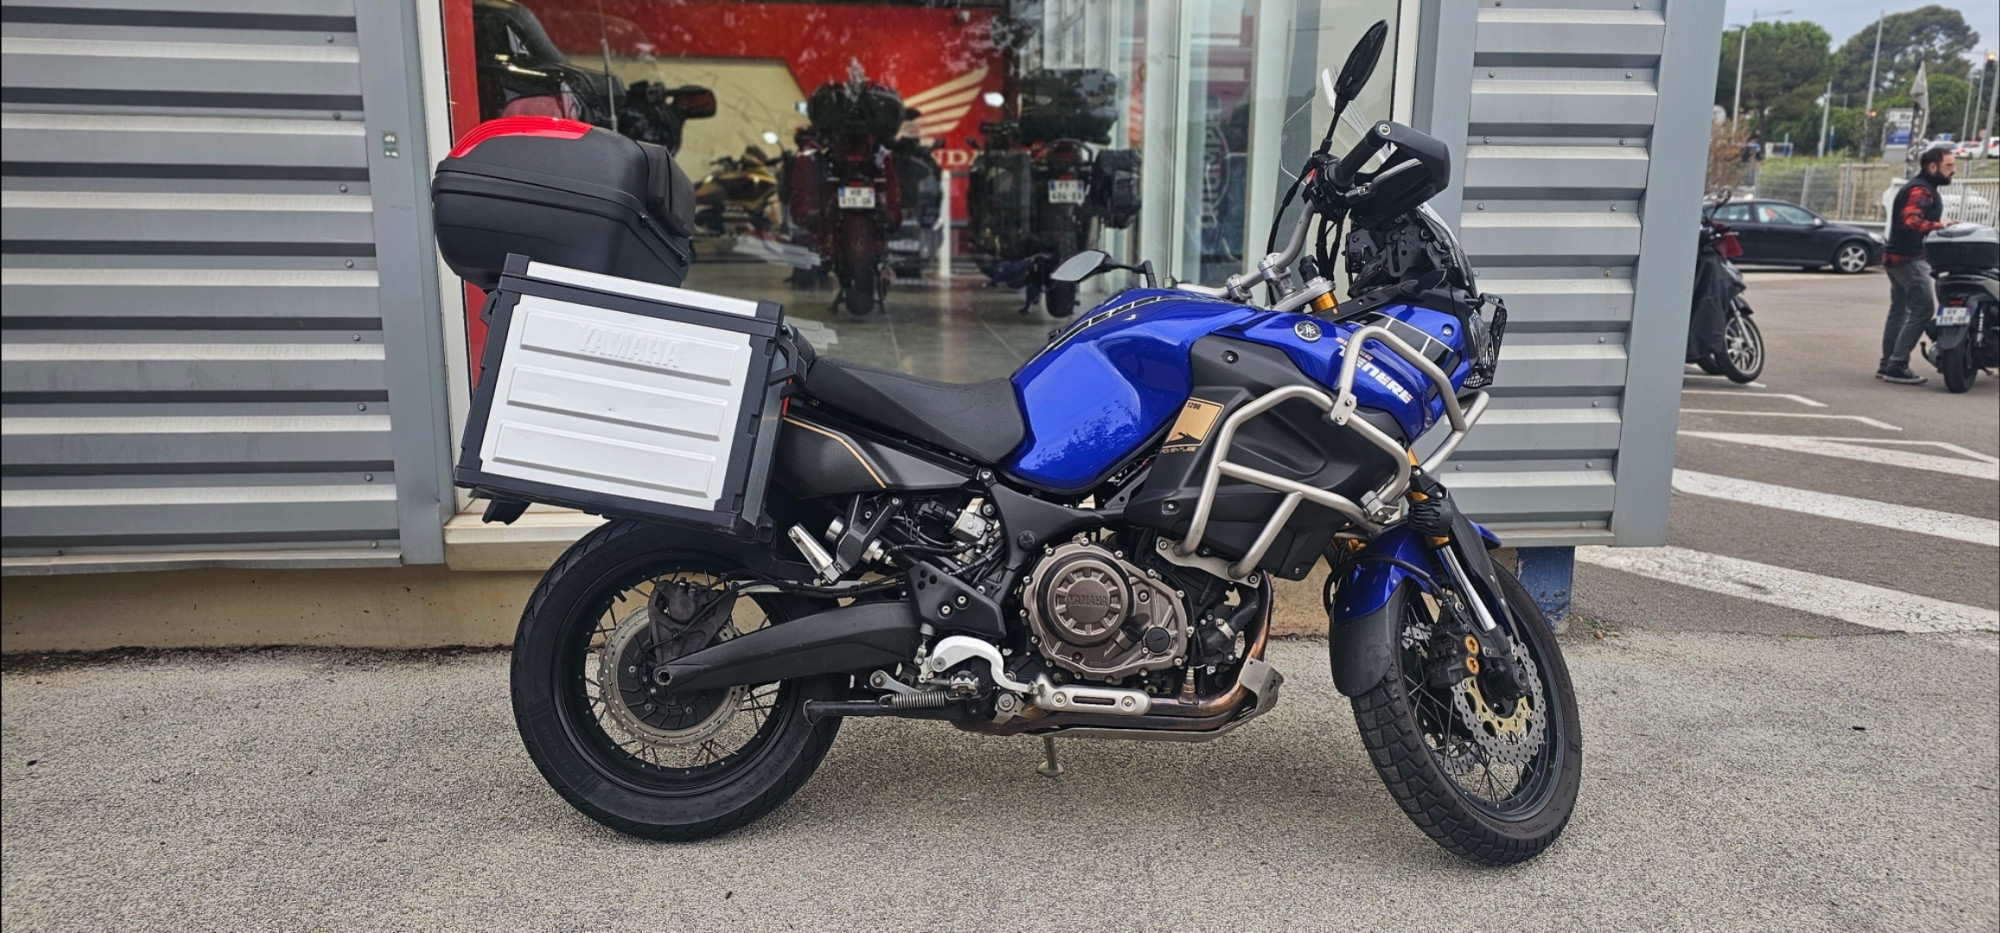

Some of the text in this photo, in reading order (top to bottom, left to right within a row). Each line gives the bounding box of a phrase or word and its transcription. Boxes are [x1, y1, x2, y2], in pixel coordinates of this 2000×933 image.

[578, 325, 679, 369] YAMAHA
[1187, 402, 1201, 410] 1200
[1068, 594, 1108, 608] YAMAHA
